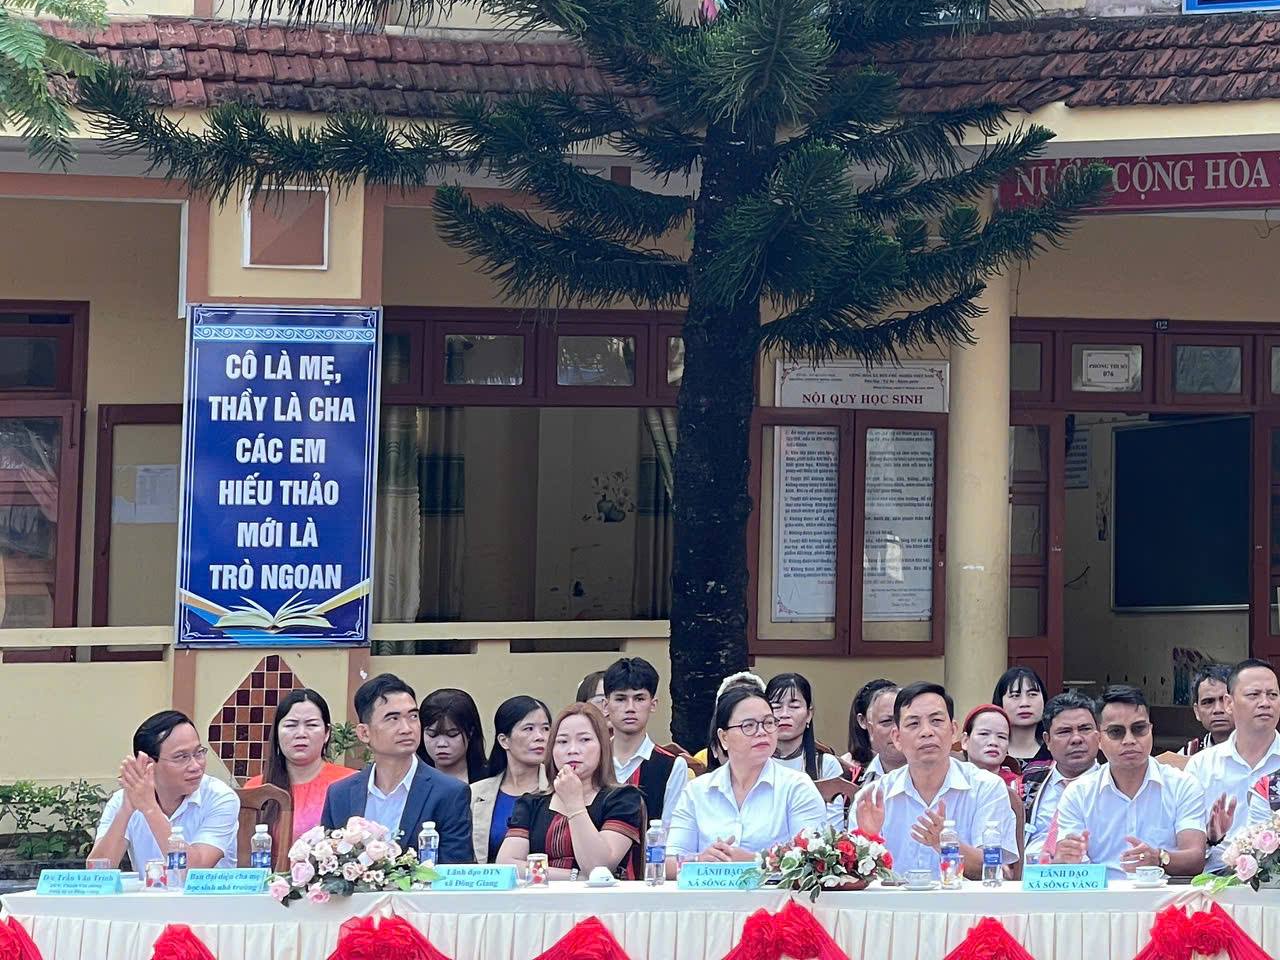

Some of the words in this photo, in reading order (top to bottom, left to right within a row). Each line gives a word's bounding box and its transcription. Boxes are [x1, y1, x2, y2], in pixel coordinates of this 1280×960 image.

[1112, 151, 1196, 200] CỘNG
[1205, 151, 1272, 190] HÒA
[226, 350, 257, 380] CÔ
[264, 350, 292, 380] LÀ
[299, 355, 342, 385] MẸ,
[208, 388, 267, 422] THẦY
[274, 392, 302, 422] LÀ
[309, 396, 356, 422] CHA
[802, 392, 826, 406] NỘI
[830, 394, 860, 406] QUY
[861, 394, 889, 406] HỌC
[892, 394, 923, 405] SINH
[236, 433, 282, 464] CÁC
[290, 439, 326, 463] EM
[218, 472, 272, 506] HIẾU
[280, 472, 339, 506] THẢO
[237, 517, 283, 548] MỚI
[289, 517, 319, 548] LÀ
[209, 558, 254, 590] TRÒ
[260, 564, 342, 590] NGOAN
